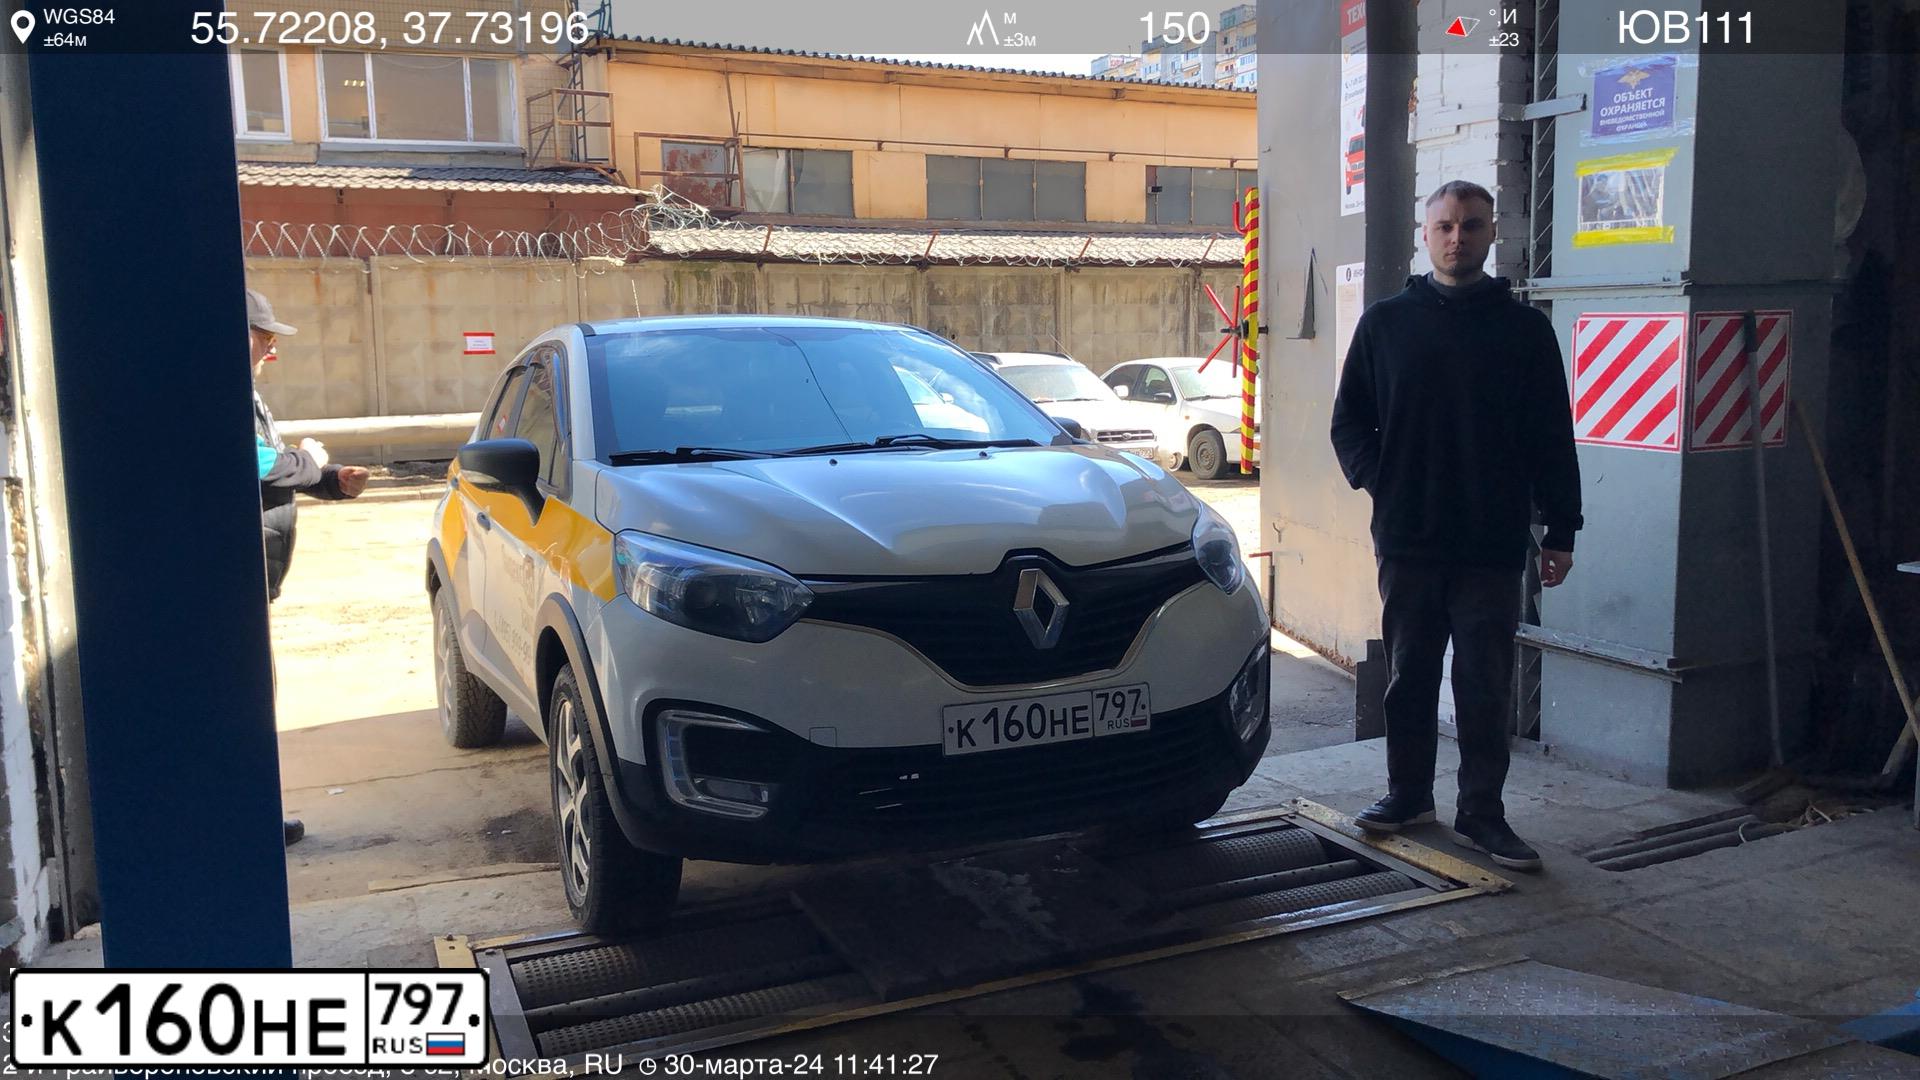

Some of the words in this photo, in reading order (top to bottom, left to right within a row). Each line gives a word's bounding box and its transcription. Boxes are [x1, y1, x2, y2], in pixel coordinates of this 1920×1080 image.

[1613, 87, 1653, 104] ОБЪЕКТ
[1599, 97, 1666, 118] ОХРАНЯЕТСЯ
[956, 702, 1090, 748] К160НЕ
[1095, 688, 1141, 721] 797
[1106, 717, 1130, 730] RUS
